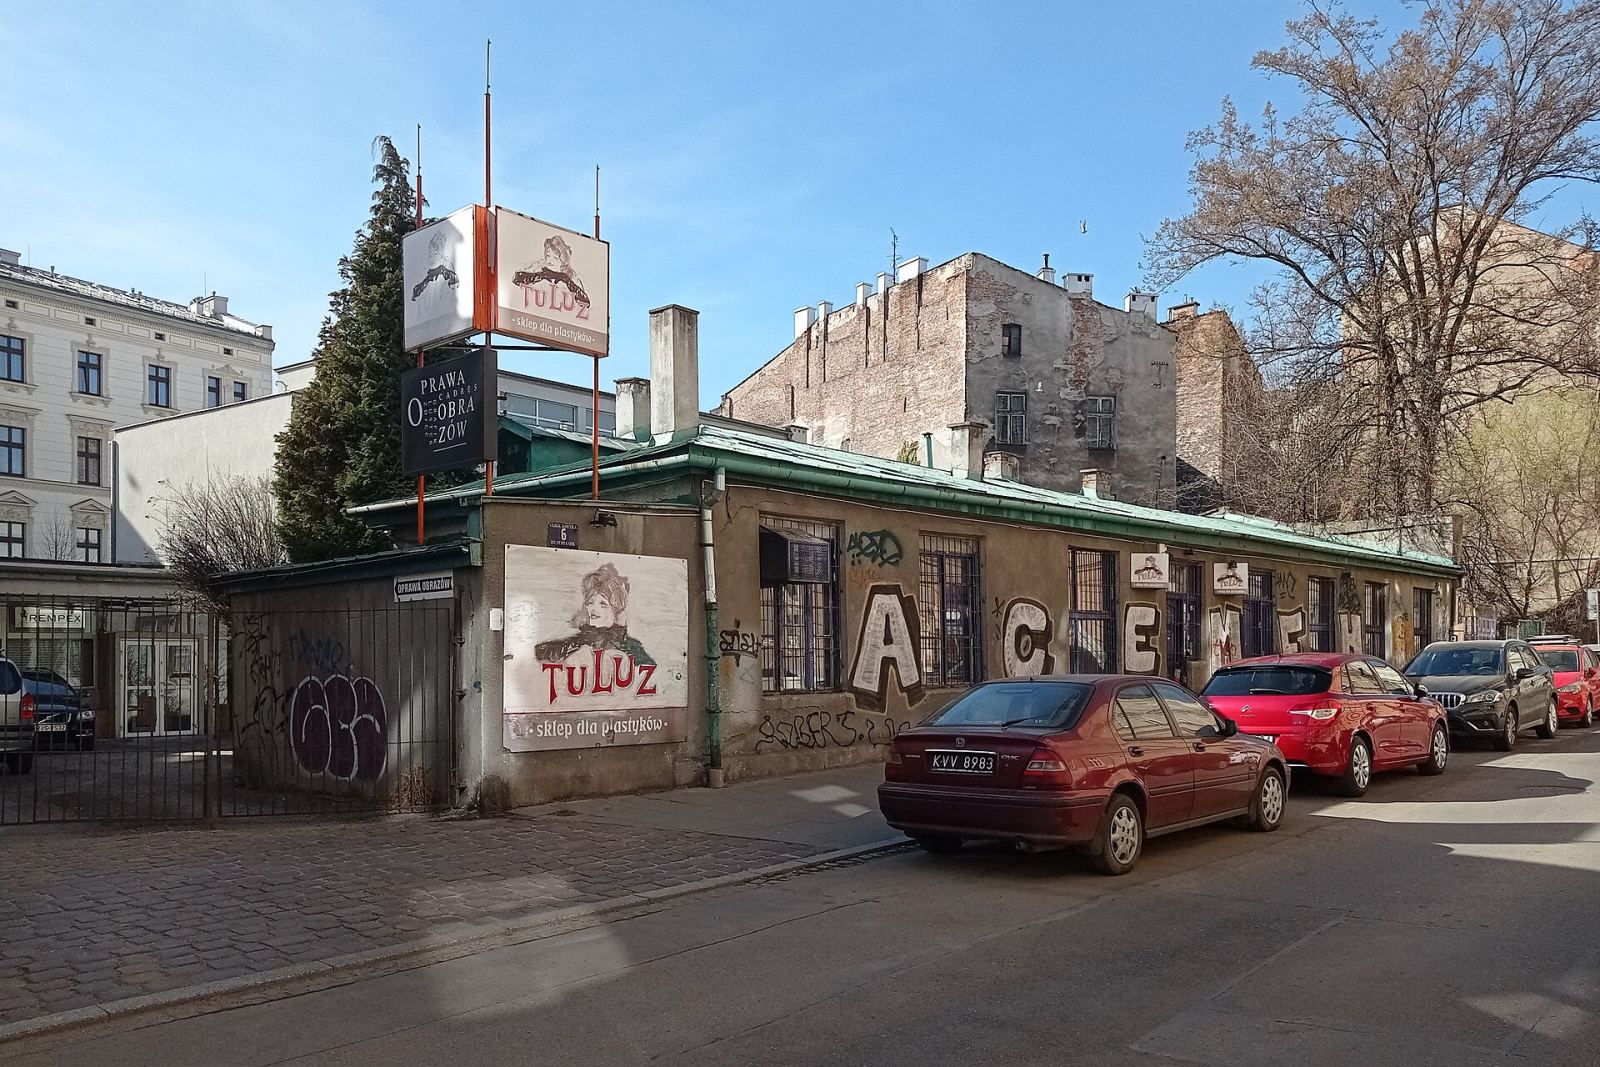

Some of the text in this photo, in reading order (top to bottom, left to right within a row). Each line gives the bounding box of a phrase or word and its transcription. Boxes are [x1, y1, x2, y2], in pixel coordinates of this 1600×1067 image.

[516, 316, 592, 344] sklep dla plastyków
[420, 369, 465, 395] PRAWA
[438, 383, 478, 401] CADRES
[437, 395, 475, 420] OBRA
[438, 418, 467, 444] ZÓW
[561, 528, 566, 541] 6
[397, 577, 450, 593] OPRAWA OBRAZÓW
[1124, 601, 1162, 677] E
[536, 714, 662, 738] sklep dla plastyków
[963, 756, 993, 770] 8983
